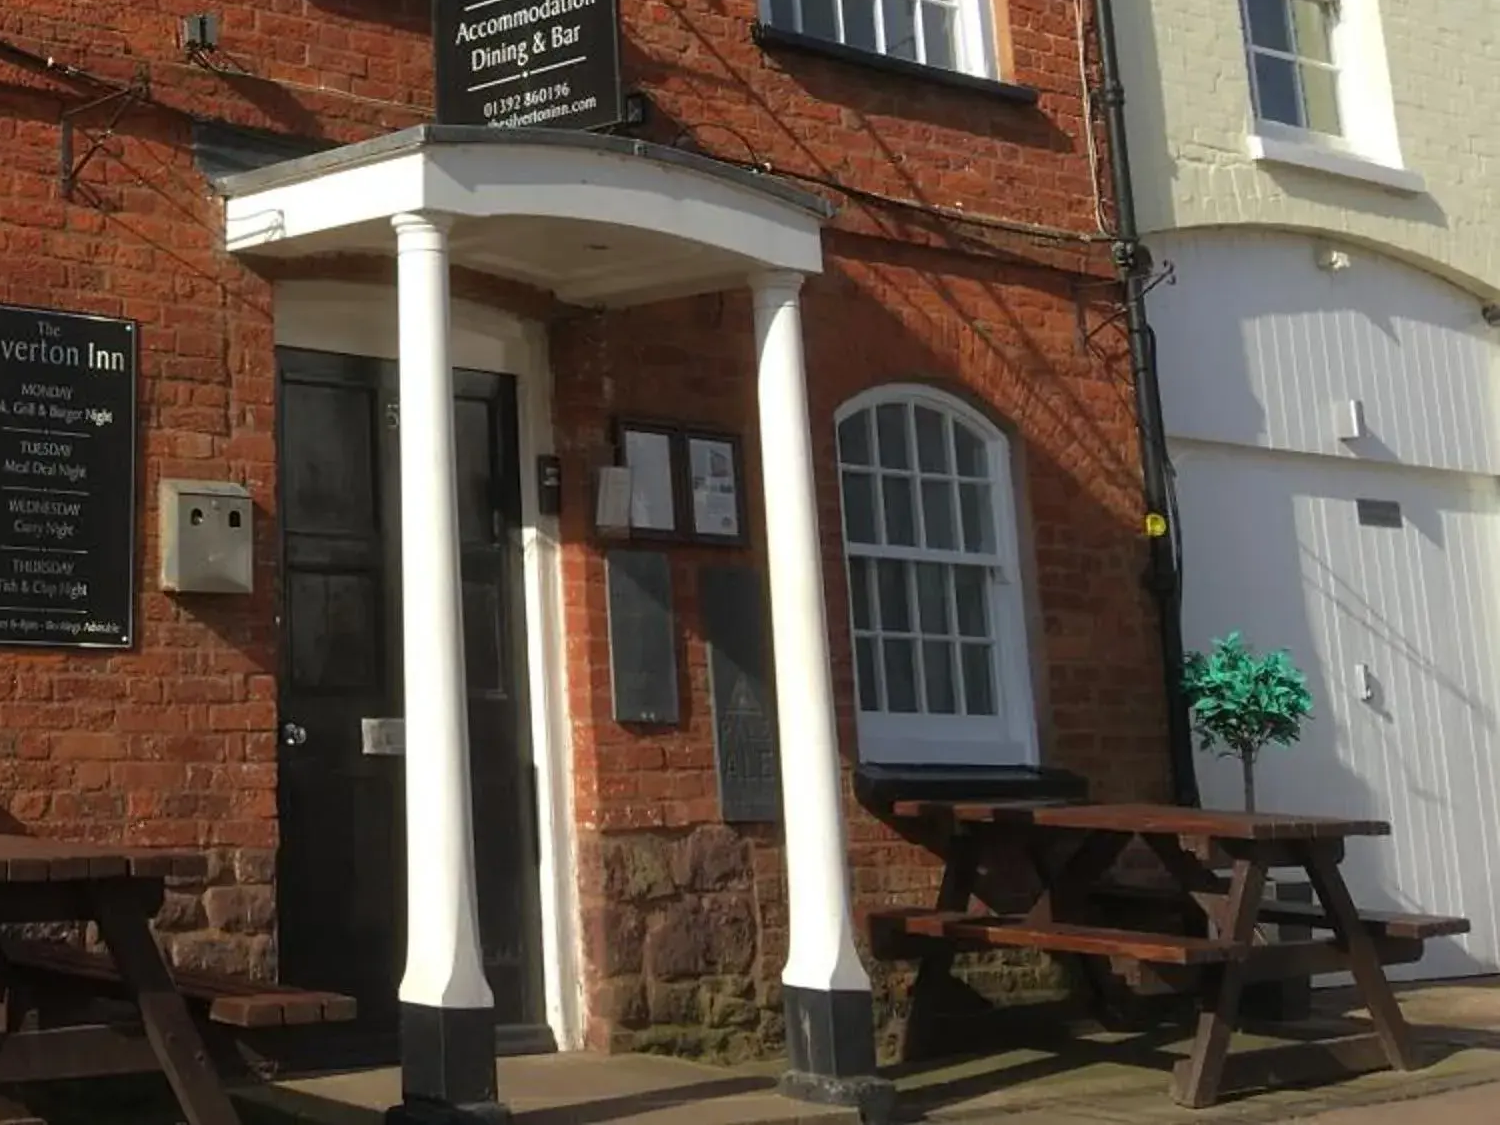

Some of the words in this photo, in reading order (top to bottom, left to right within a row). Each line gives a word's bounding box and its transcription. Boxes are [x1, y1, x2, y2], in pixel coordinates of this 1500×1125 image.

[471, 38, 529, 72] Dining
[532, 31, 547, 55] &
[551, 23, 581, 49] Bar
[483, 94, 521, 118] 01392
[37, 321, 61, 337] The
[88, 342, 125, 372] Inn
[20, 383, 75, 401] MONDAY
[50, 406, 83, 424] Burger
[85, 408, 113, 427] Night
[20, 440, 74, 458] TUESDAY
[4, 458, 29, 474] Meal
[32, 461, 57, 476] Deal
[59, 464, 87, 482] Night
[8, 498, 82, 516] WEDNESDAY
[13, 519, 44, 539] Curry
[46, 522, 75, 540] Night
[12, 558, 75, 576] THURSDAY
[61, 581, 88, 600] Night
